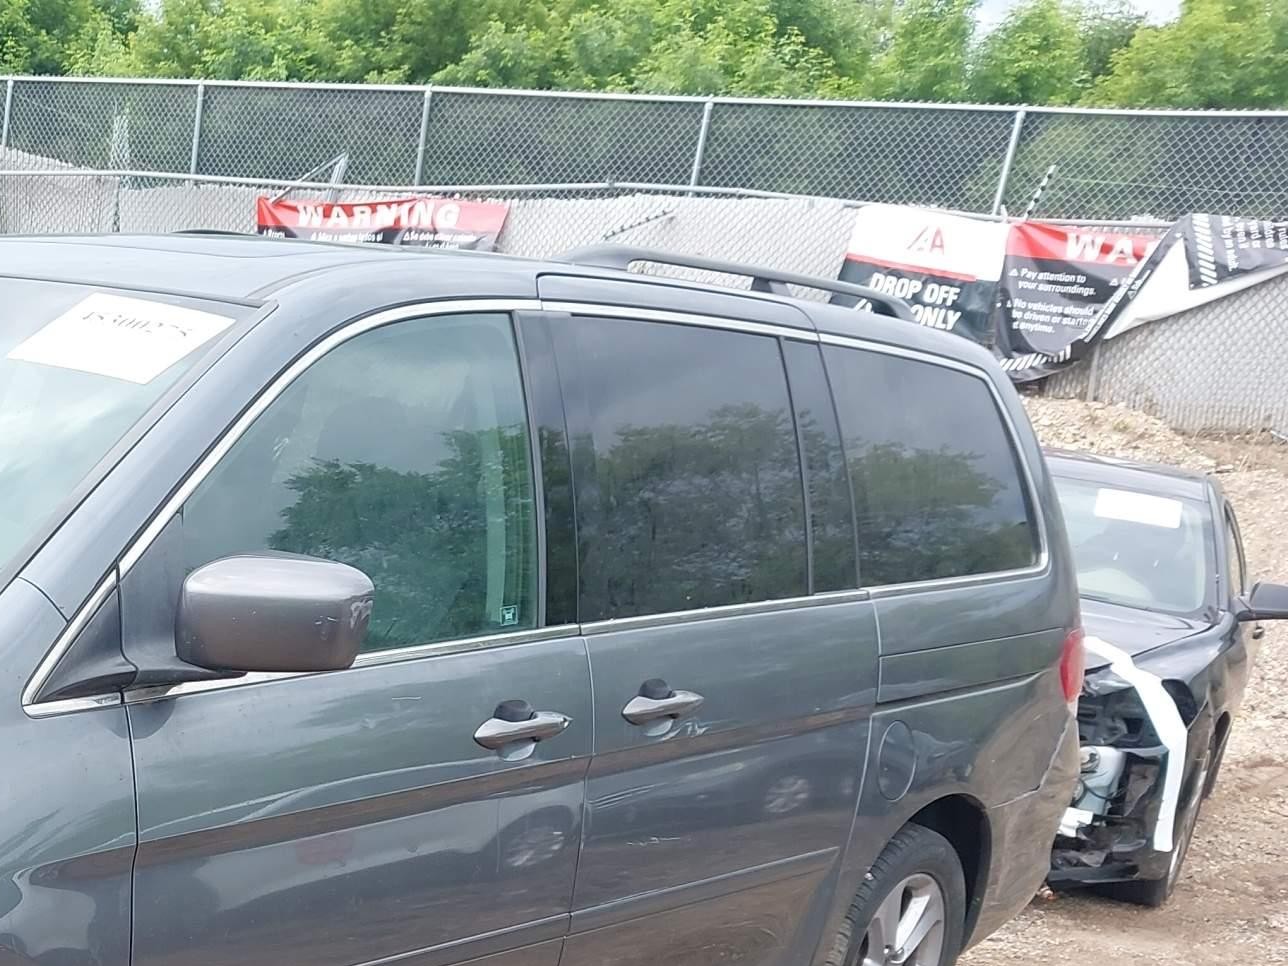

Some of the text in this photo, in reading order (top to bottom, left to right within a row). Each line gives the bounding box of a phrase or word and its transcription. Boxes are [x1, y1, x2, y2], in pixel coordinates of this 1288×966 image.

[298, 202, 462, 230] WARNING
[1020, 267, 1087, 284] Pay attention to
[868, 271, 961, 306] DROP OFF
[1018, 280, 1097, 297] your surroundings.
[911, 303, 962, 331] ONLY
[1024, 311, 1050, 322] driven
[1051, 315, 1060, 323] or
[1028, 301, 1063, 314] vehicles
[1064, 304, 1095, 316] should
